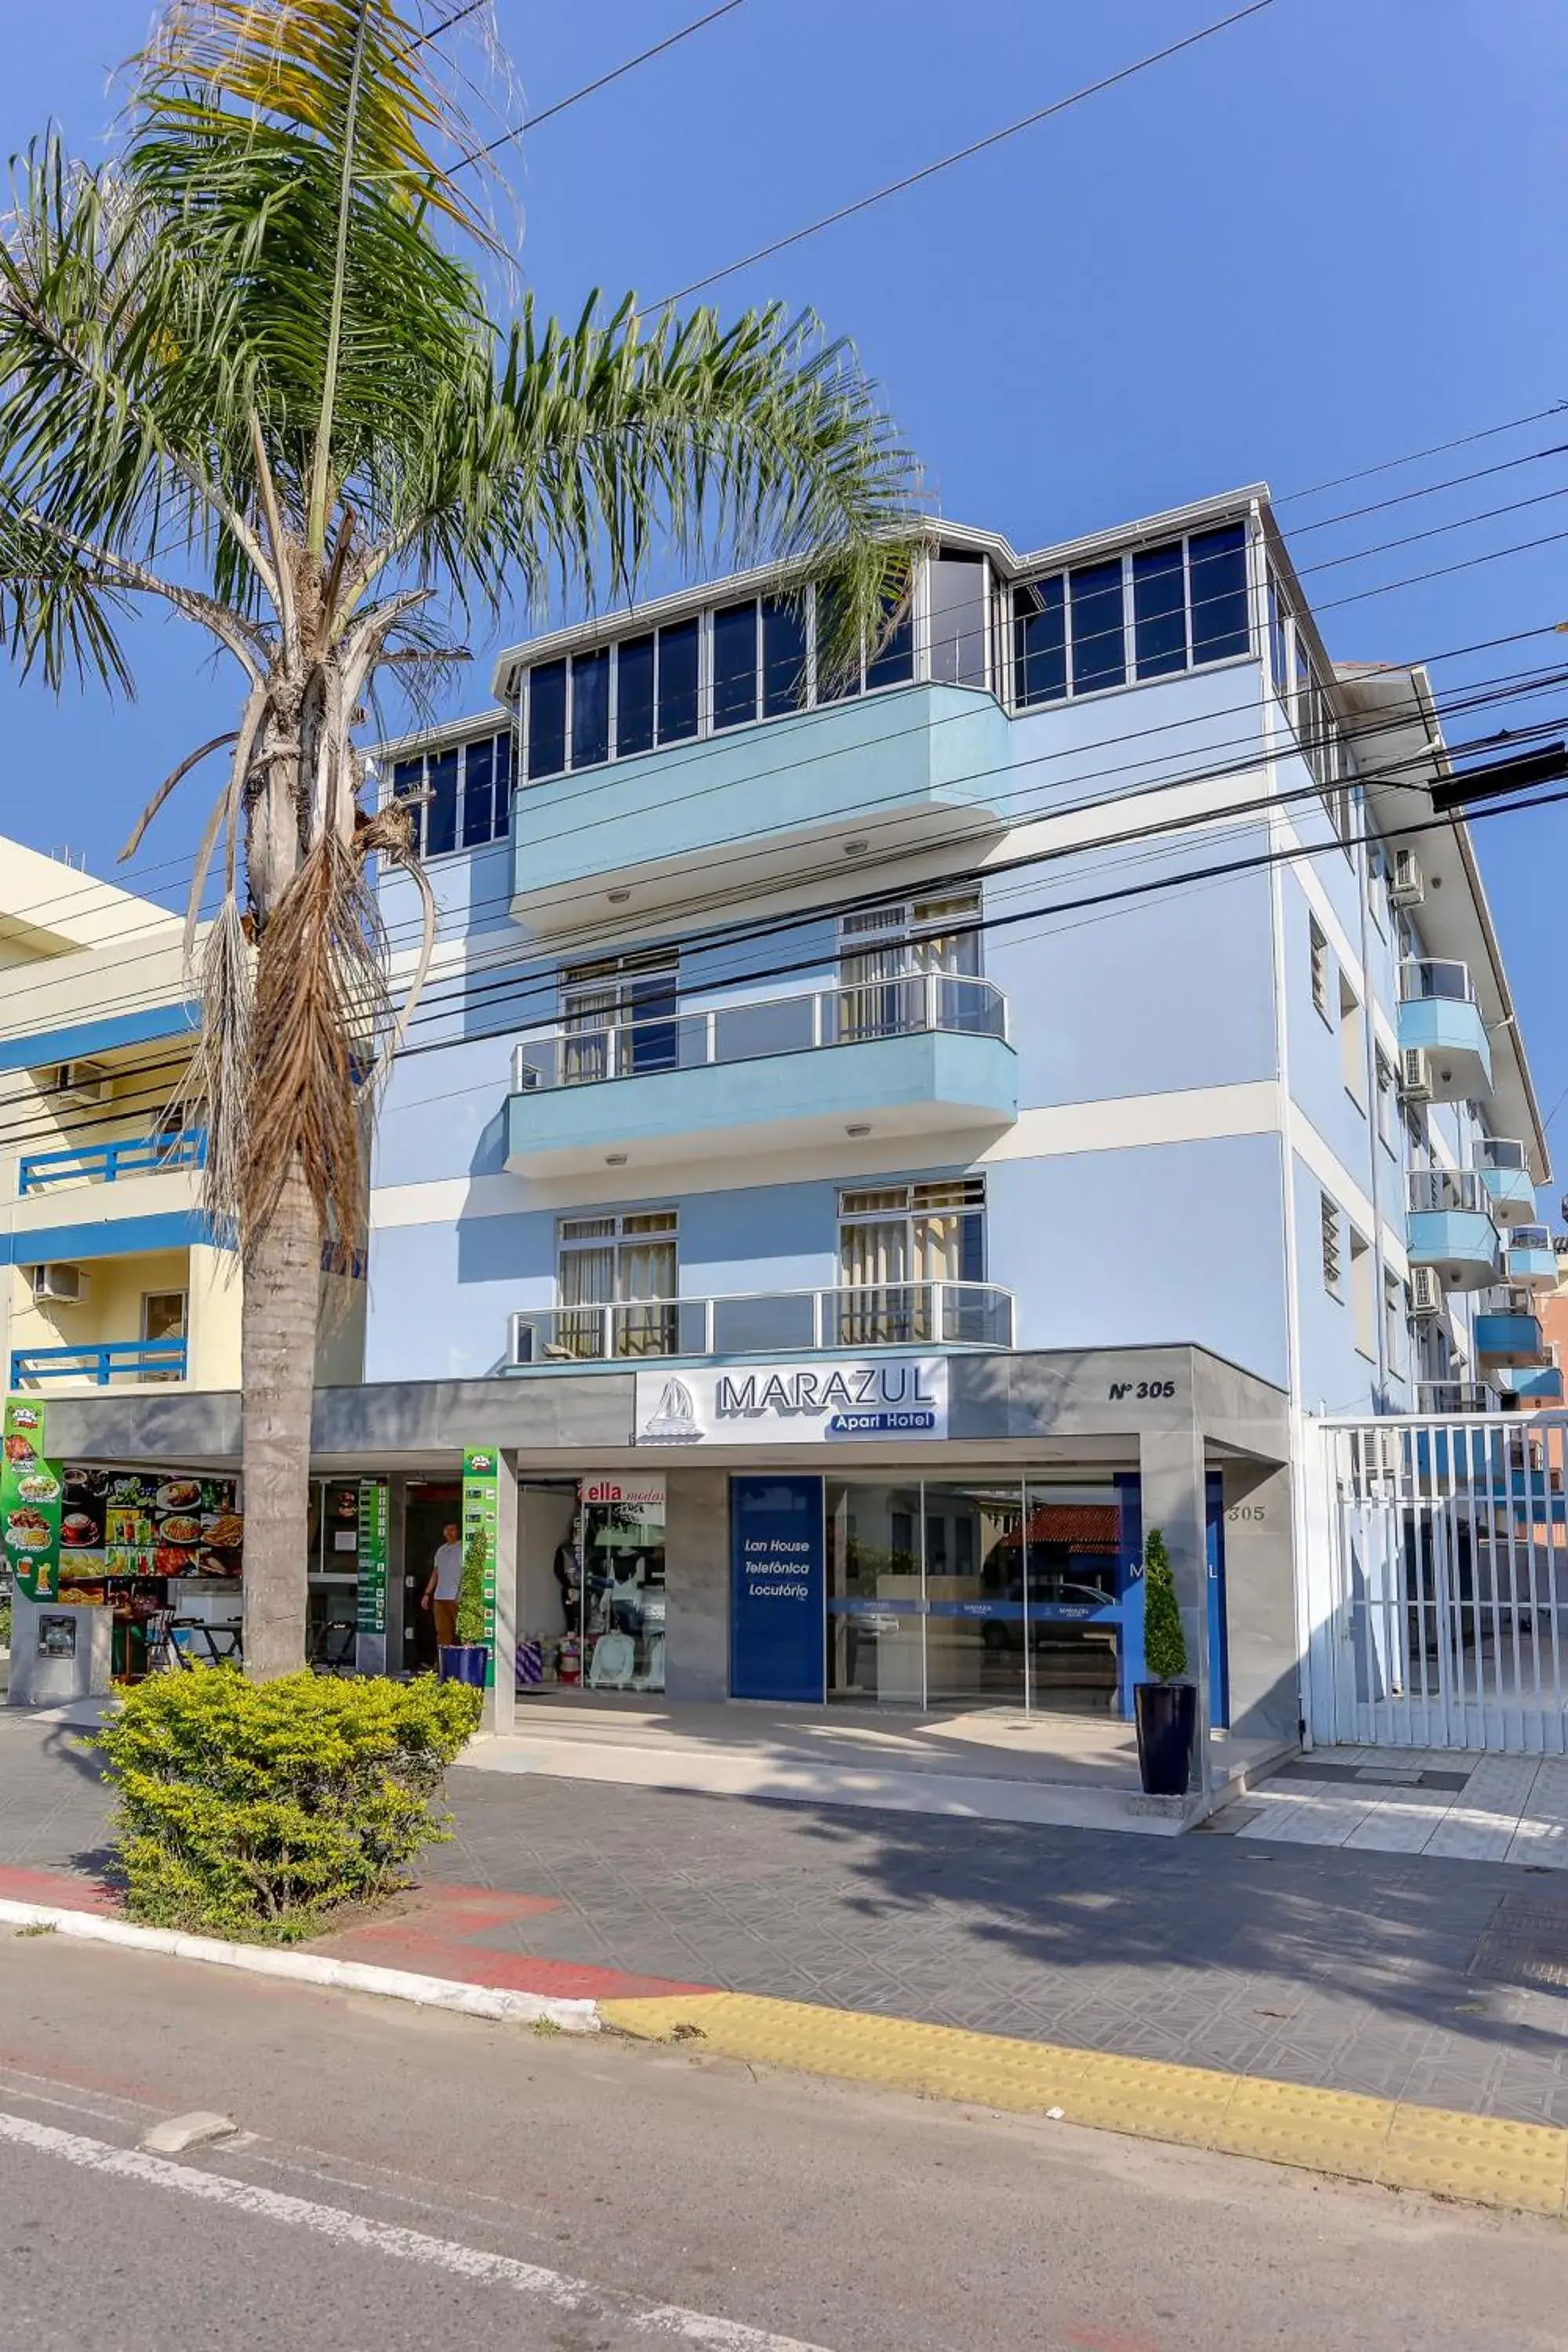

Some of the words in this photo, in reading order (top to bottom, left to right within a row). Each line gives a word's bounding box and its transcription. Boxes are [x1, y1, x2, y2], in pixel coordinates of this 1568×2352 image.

[722, 1367, 934, 1408] MARAZUL
[1136, 1381, 1175, 1399] 305
[836, 1414, 880, 1430] Apart
[887, 1411, 930, 1428] Hotel
[589, 1481, 622, 1501] ella
[1229, 1505, 1265, 1522] 305
[744, 1538, 768, 1552] Lan
[770, 1538, 810, 1552] House
